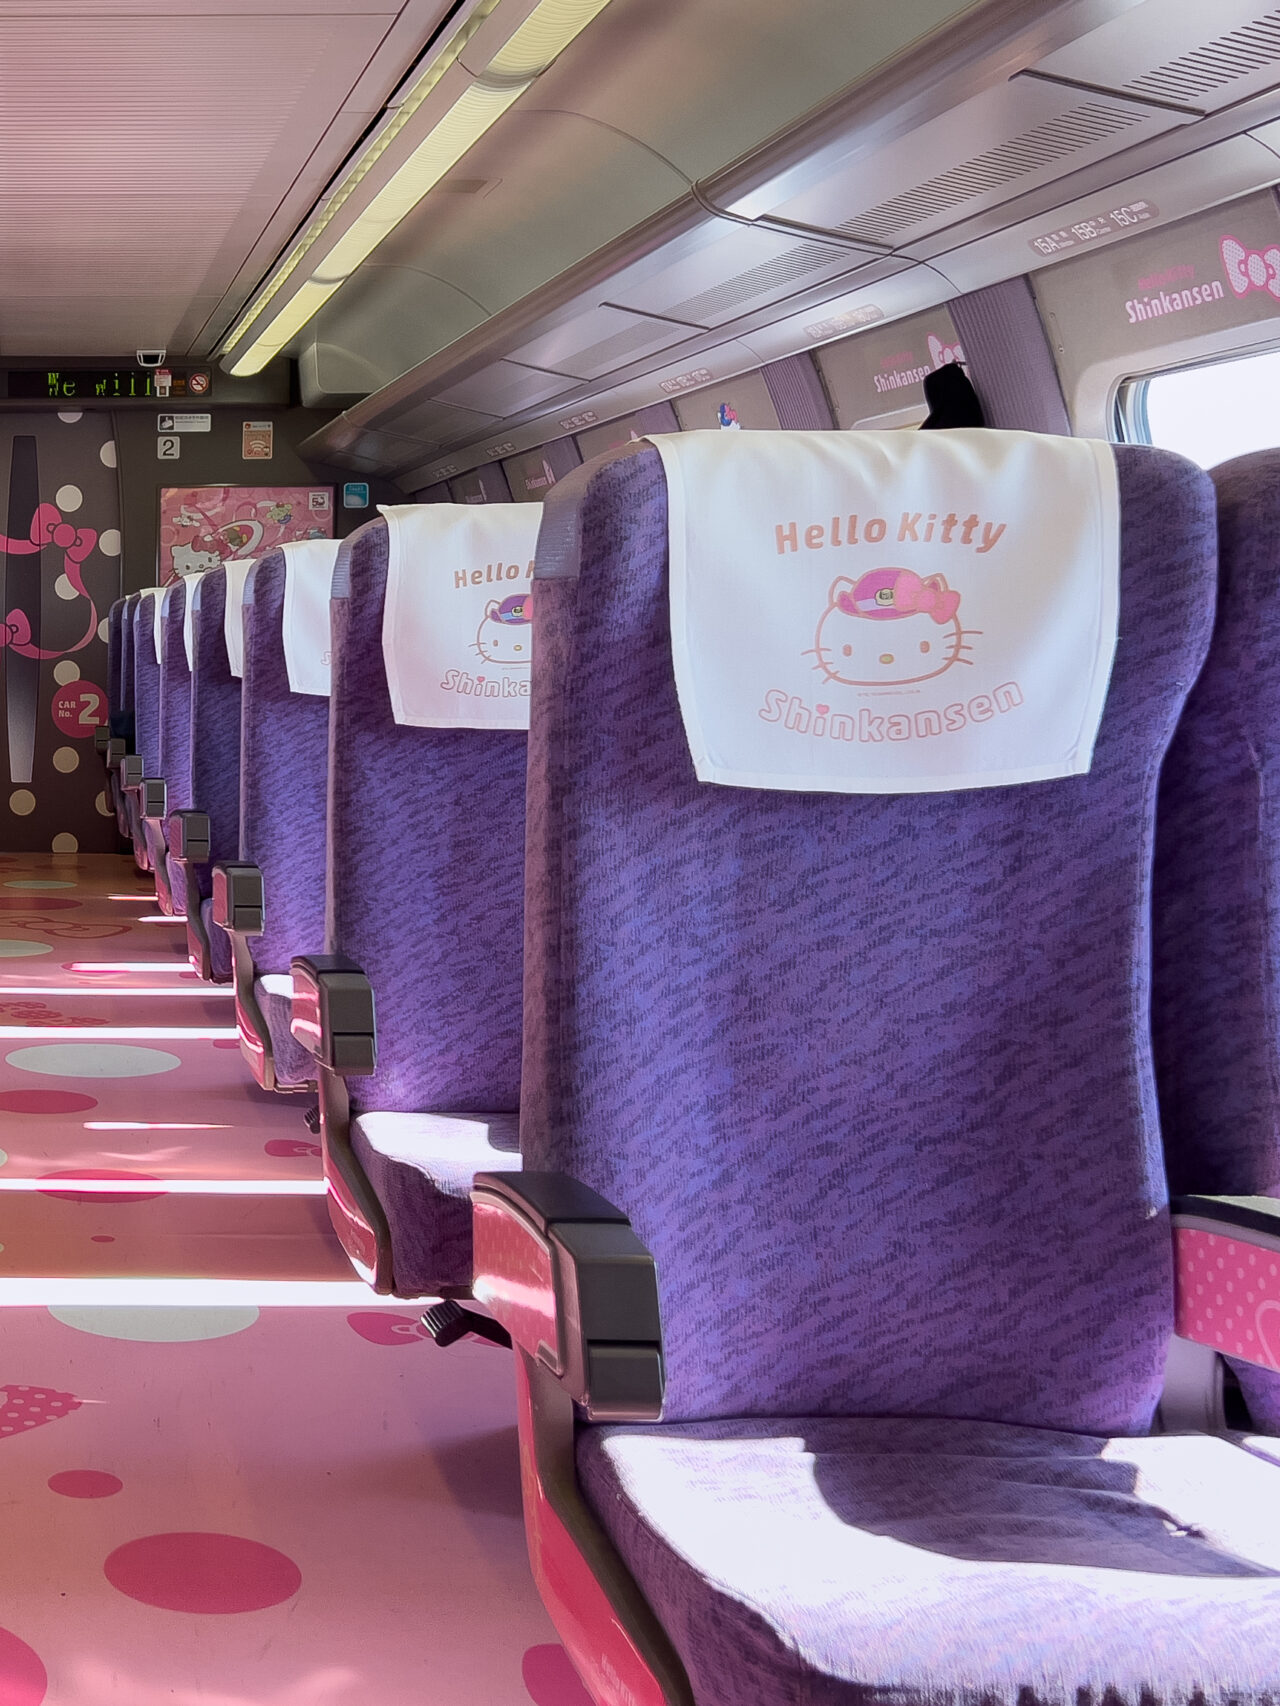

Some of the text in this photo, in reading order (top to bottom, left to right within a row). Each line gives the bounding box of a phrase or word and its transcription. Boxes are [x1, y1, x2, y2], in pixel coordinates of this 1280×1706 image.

[1034, 238, 1061, 255] 15A
[1071, 222, 1098, 241] 15B
[1109, 207, 1138, 227] 15C
[1125, 280, 1224, 323] Shinkansen
[48, 373, 76, 396] We
[163, 440, 174, 456] 2
[775, 512, 1007, 555] Hello Kitty
[454, 562, 519, 589] Hello
[58, 693, 100, 724] CAR 2
[58, 709, 73, 718] No.
[758, 681, 1024, 743] Shinkansen
